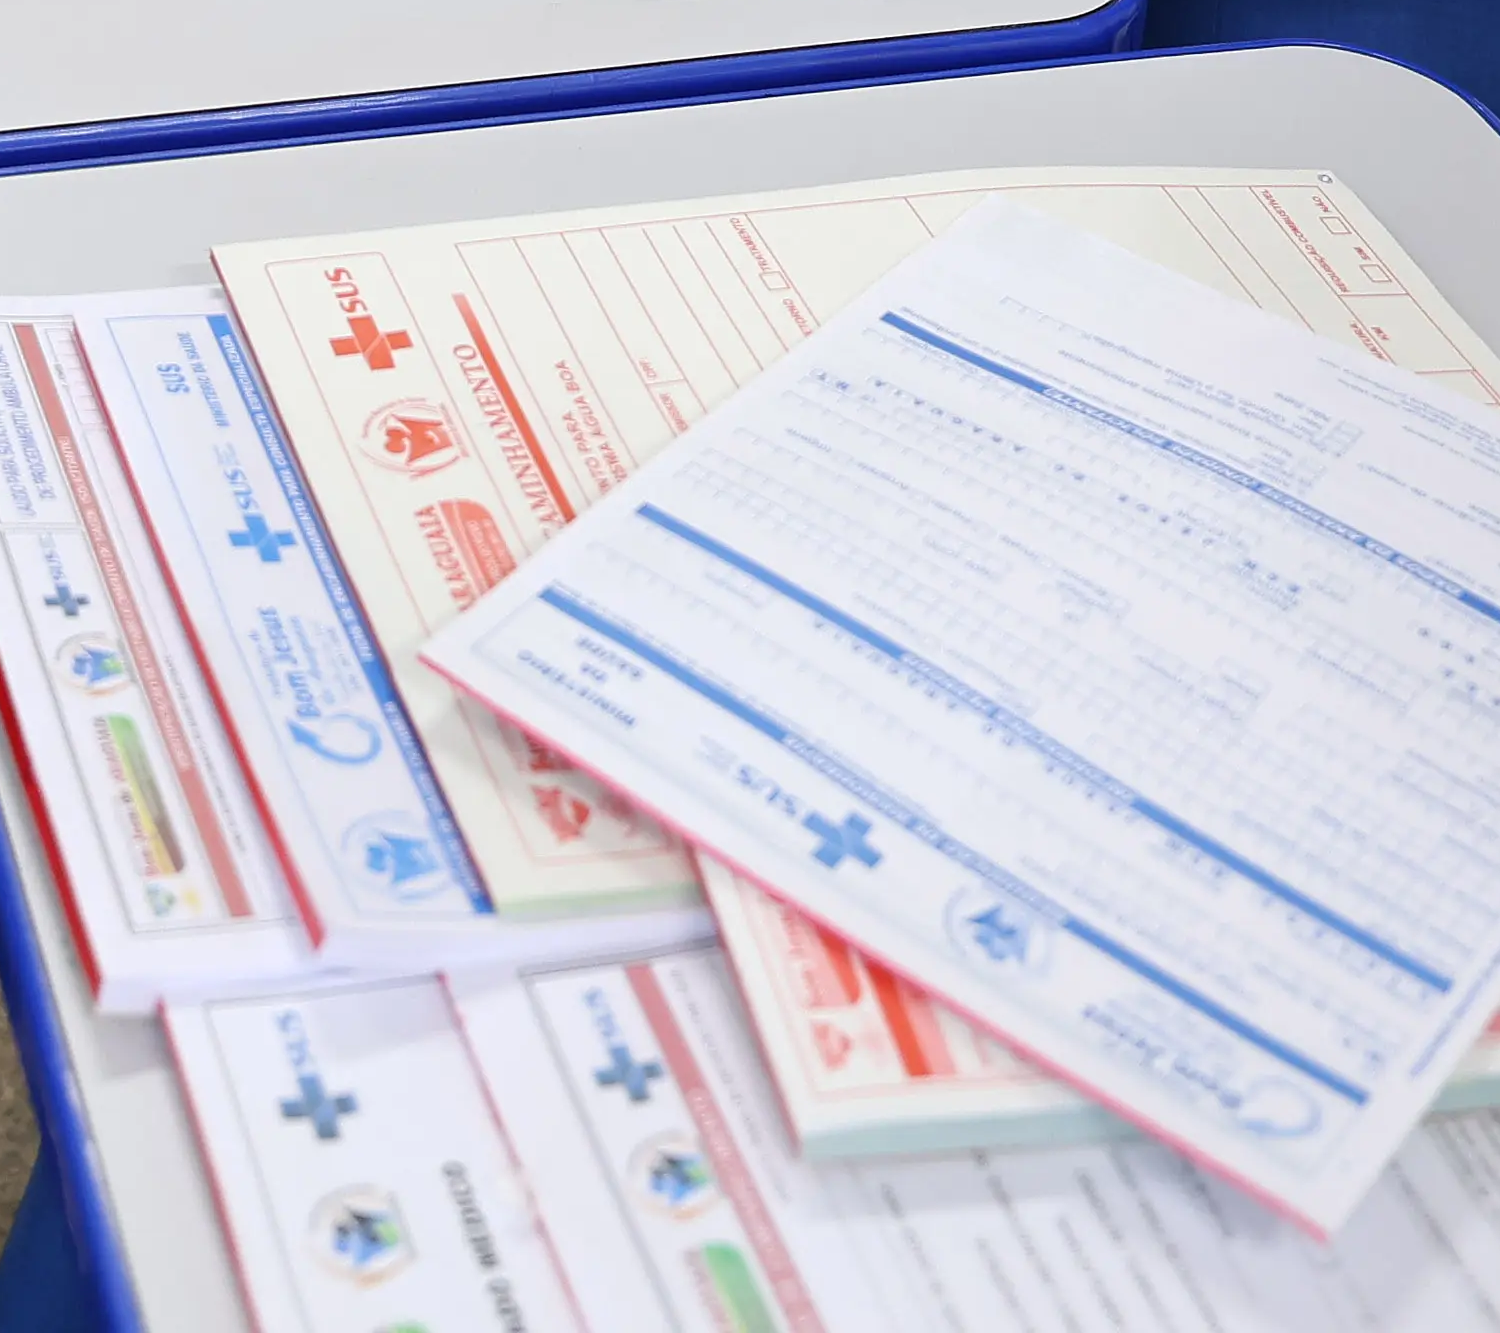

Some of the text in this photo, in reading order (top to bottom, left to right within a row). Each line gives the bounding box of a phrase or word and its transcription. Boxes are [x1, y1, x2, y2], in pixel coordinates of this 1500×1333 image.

[1259, 186, 1310, 244] COMBUSTÍVEL
[1310, 193, 1331, 216] NÃO
[728, 214, 771, 273] TRATAMENTO
[1304, 241, 1350, 295] REQUISIÇÃO
[323, 262, 368, 319] SUS
[154, 357, 191, 398] SUS
[553, 358, 581, 395] BOA
[8, 408, 51, 486] PROCEDIMENTO
[560, 409, 592, 455] PARA
[222, 464, 260, 514] SUS
[412, 503, 476, 612] RAGUAIA
[282, 667, 322, 720] Bom
